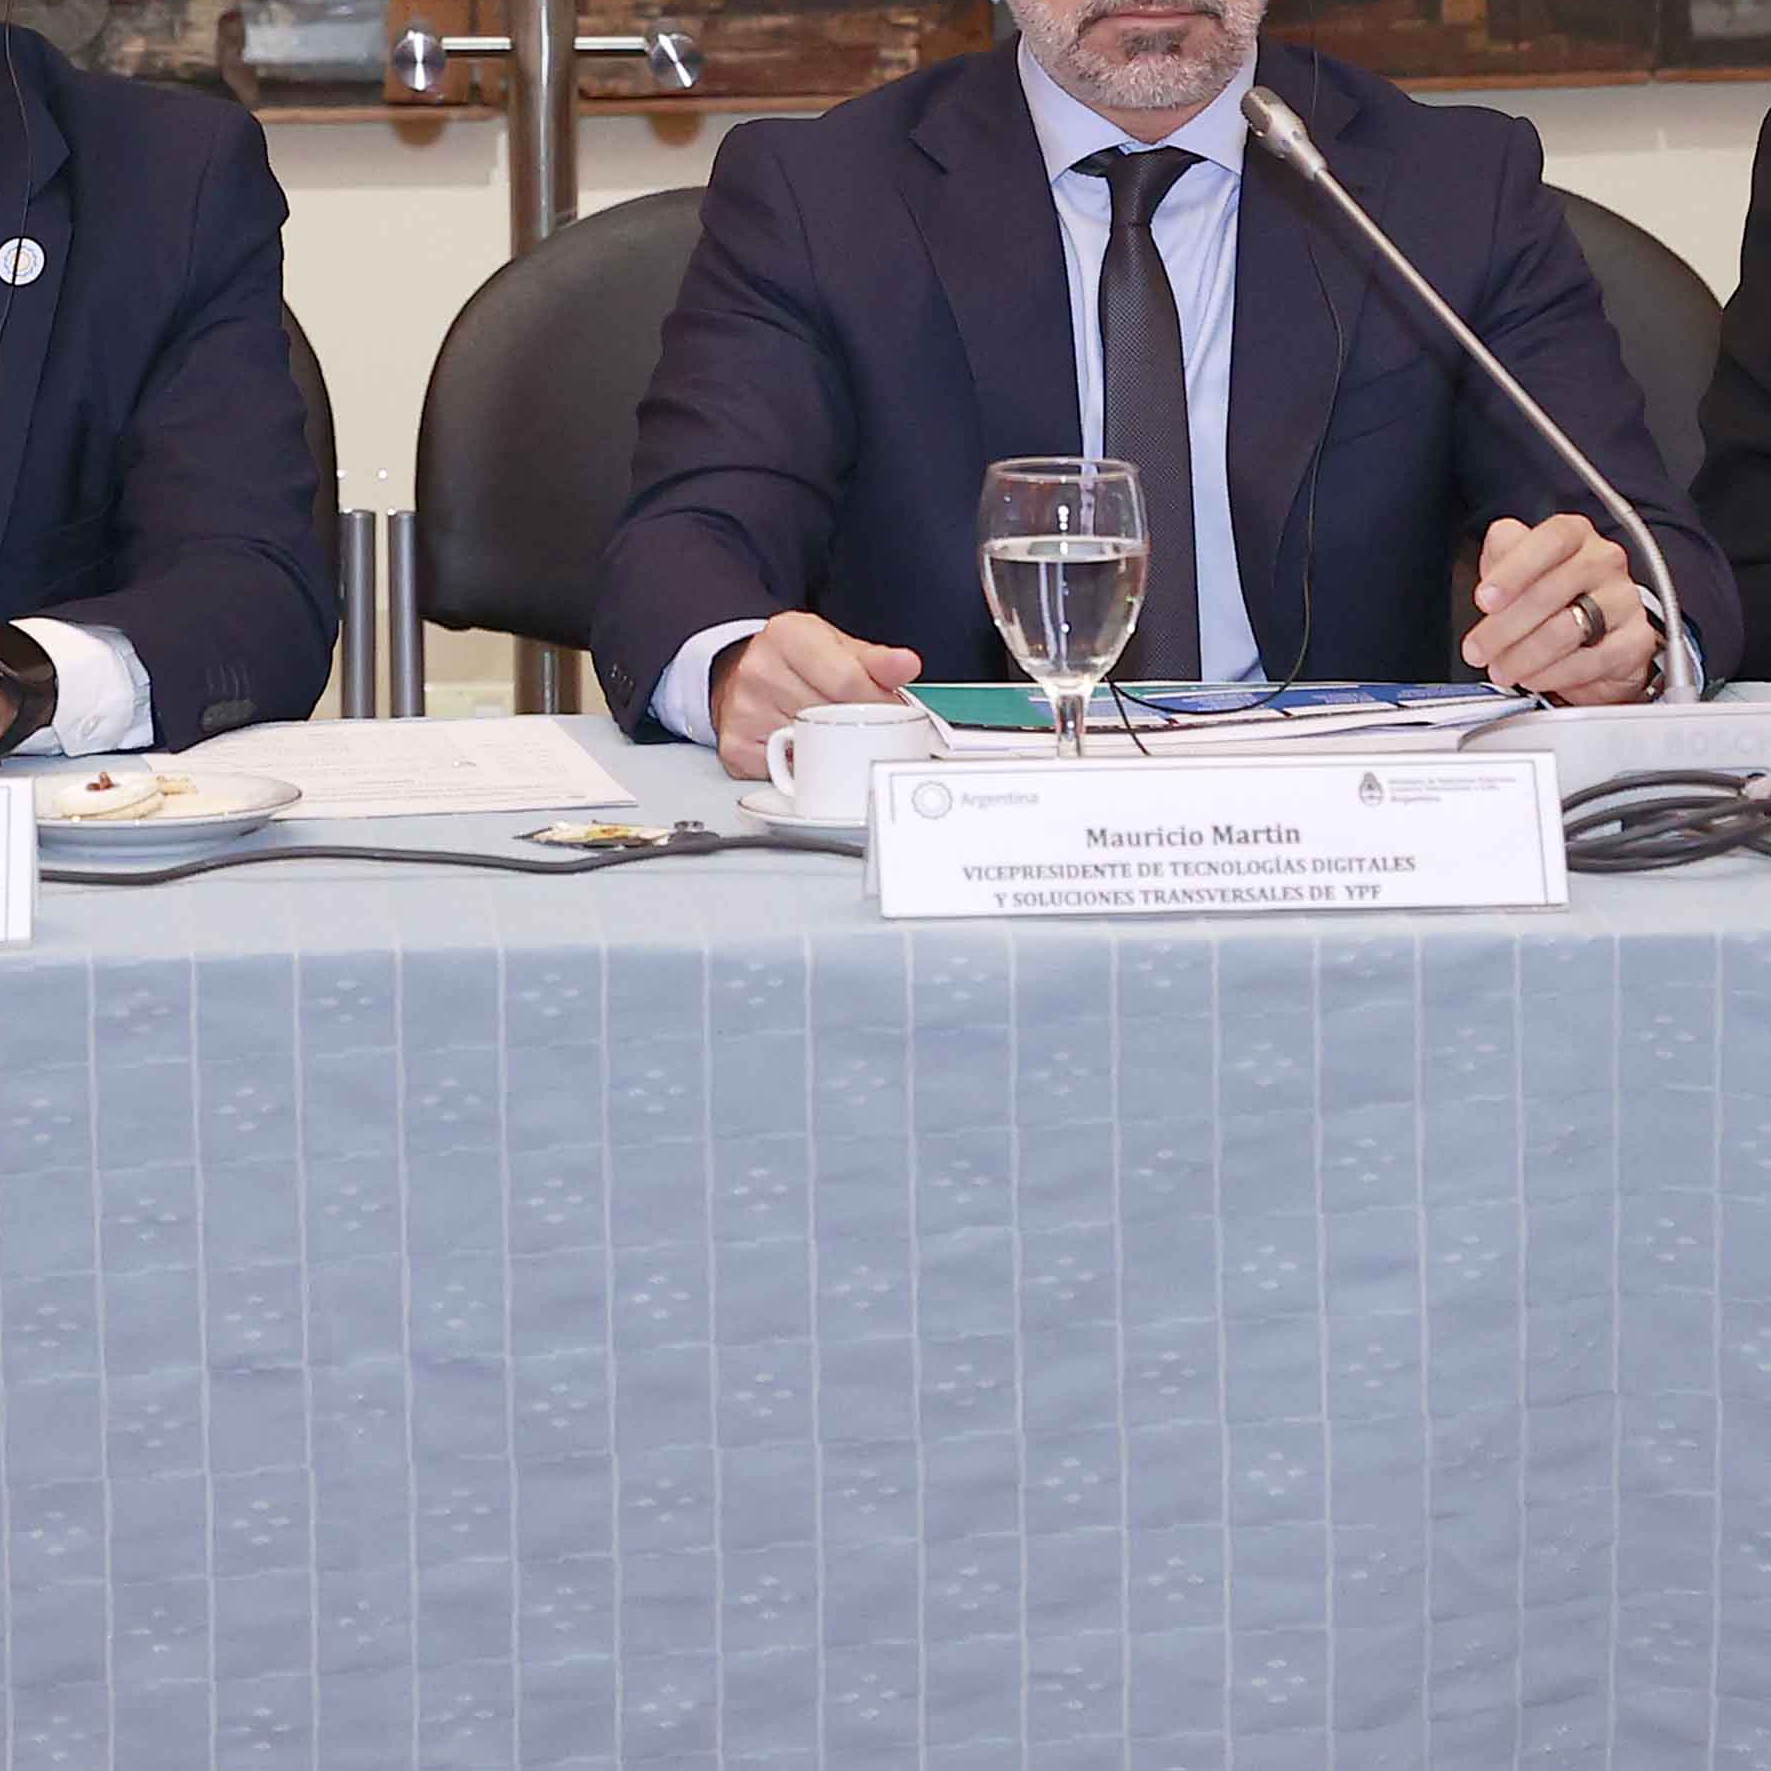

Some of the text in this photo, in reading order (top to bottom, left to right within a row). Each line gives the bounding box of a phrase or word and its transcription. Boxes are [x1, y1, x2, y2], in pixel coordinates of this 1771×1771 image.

[960, 791, 1040, 809] Argentina
[1086, 824, 1301, 848] Mauricio Martin
[963, 856, 1416, 881] VICEPRESIDENTE DE TECNOLOGÍAS DIGITALES
[994, 883, 1381, 909] Y SOLUCIONES TRANSVERSALES DE YPF
